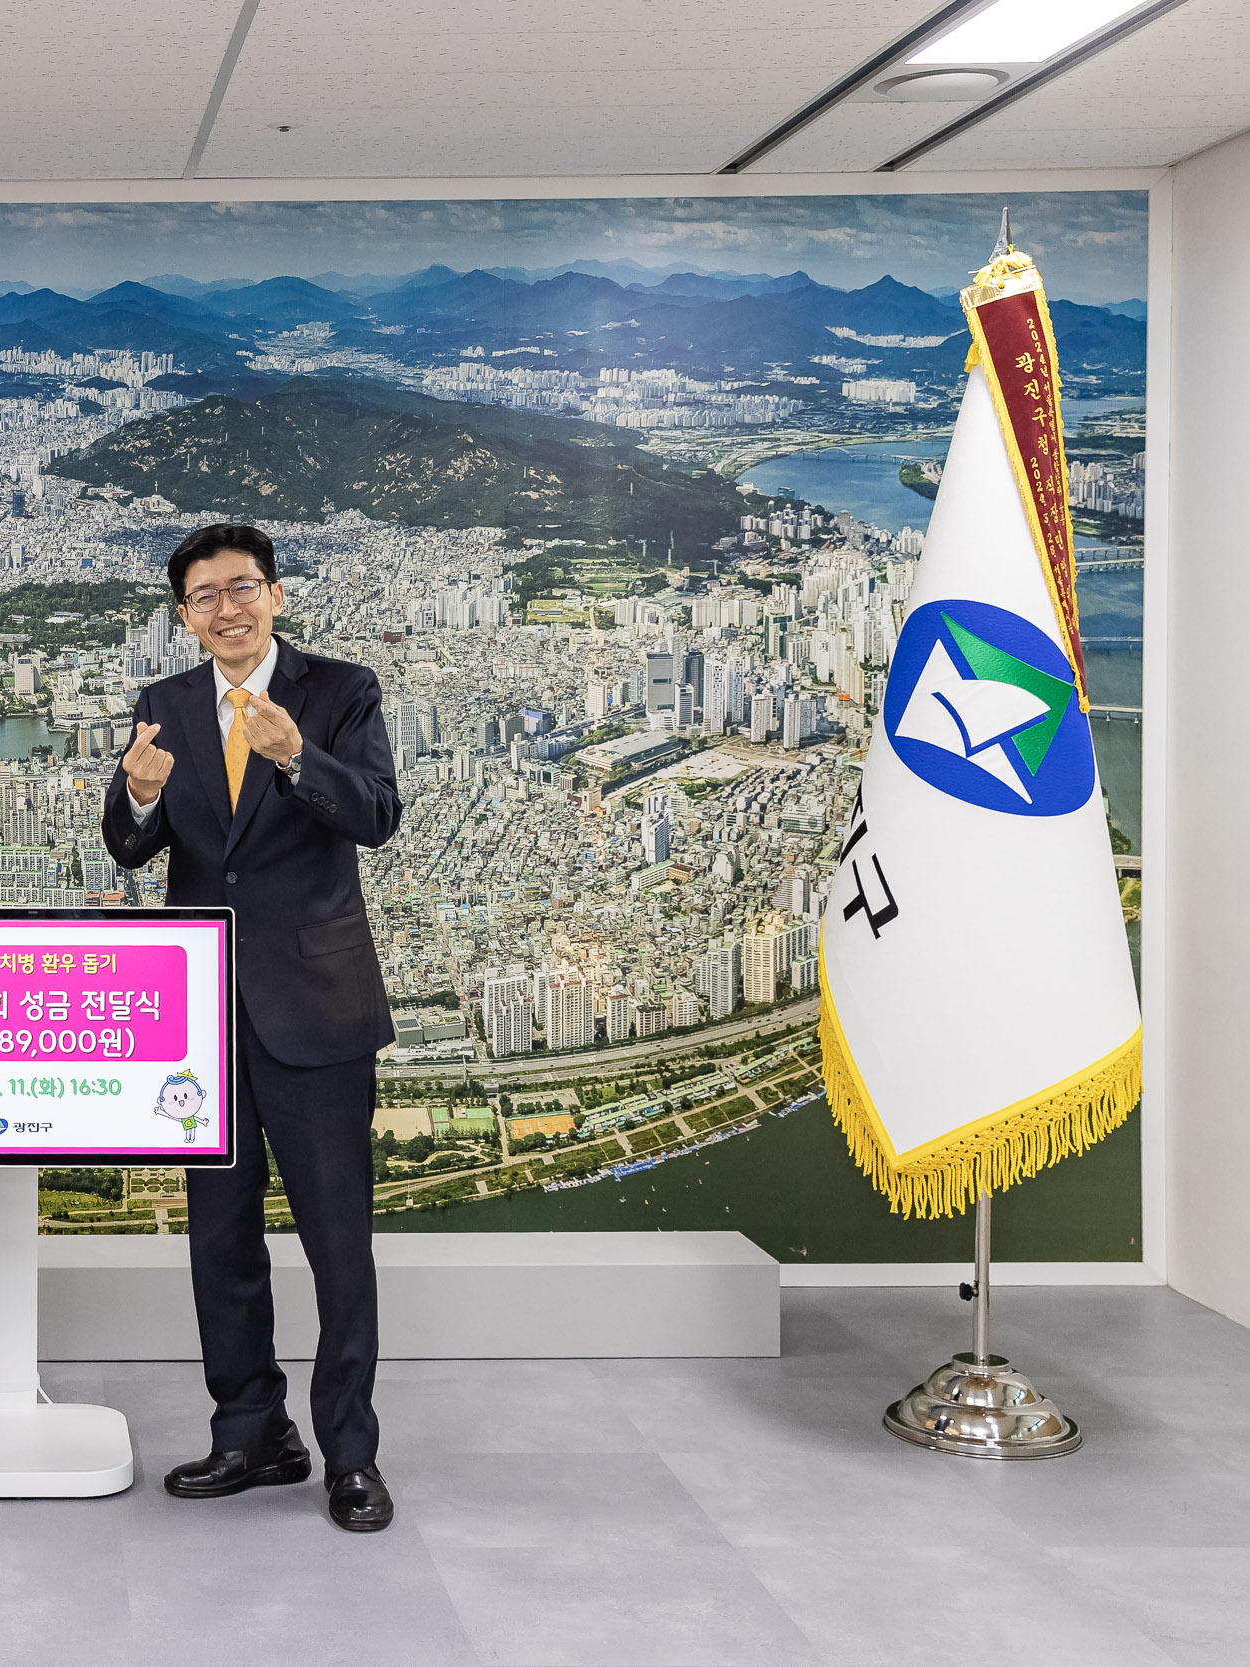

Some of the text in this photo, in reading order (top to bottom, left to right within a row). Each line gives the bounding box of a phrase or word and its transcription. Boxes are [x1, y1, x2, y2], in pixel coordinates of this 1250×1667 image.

[1026, 317, 1049, 378] 2024년
[1015, 352, 1049, 456] 광진구청
[41, 952, 77, 975] 환우
[81, 952, 118, 975] 돕기
[18, 989, 72, 1021] 성금
[80, 989, 161, 1021] 전달식
[8, 1076, 65, 1099] 11.(화)
[69, 1078, 122, 1096] 16:30
[12, 1122, 53, 1134] 광진구
